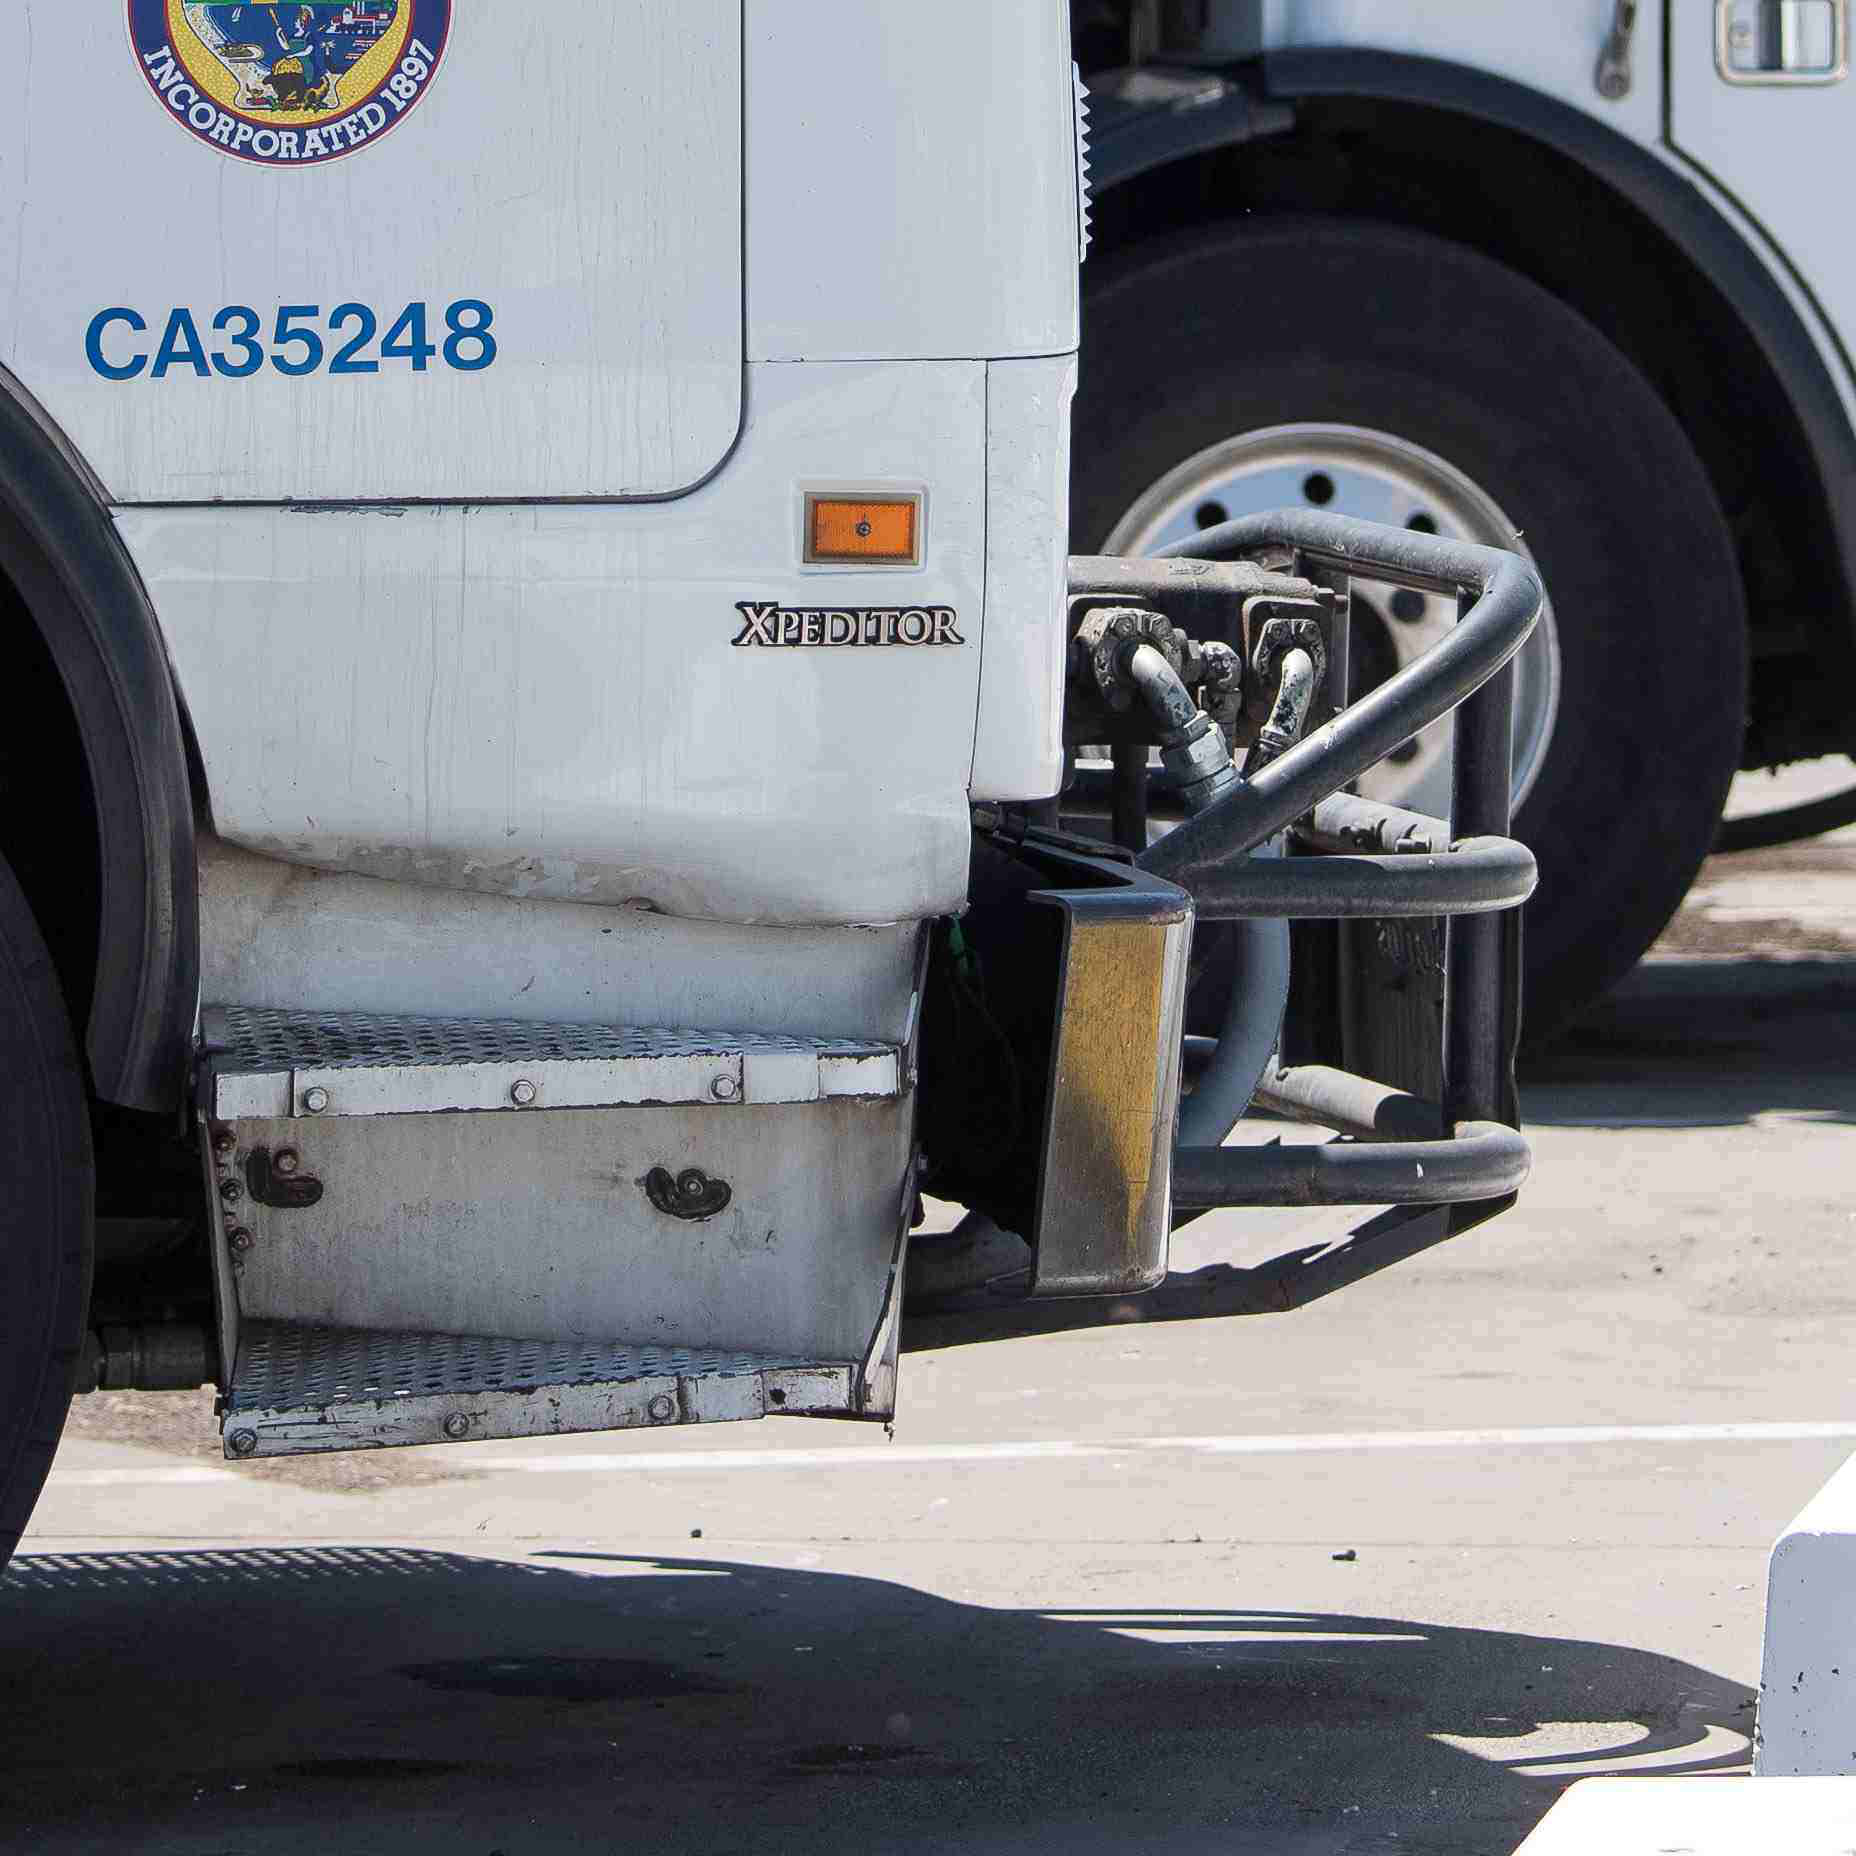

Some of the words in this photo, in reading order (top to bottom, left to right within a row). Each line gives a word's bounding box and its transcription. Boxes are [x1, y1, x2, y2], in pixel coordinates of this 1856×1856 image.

[143, 45, 386, 158] INCORPORATED
[380, 38, 435, 112] 1897
[85, 299, 497, 380] CA35248
[732, 602, 965, 646] XPEDITOR
